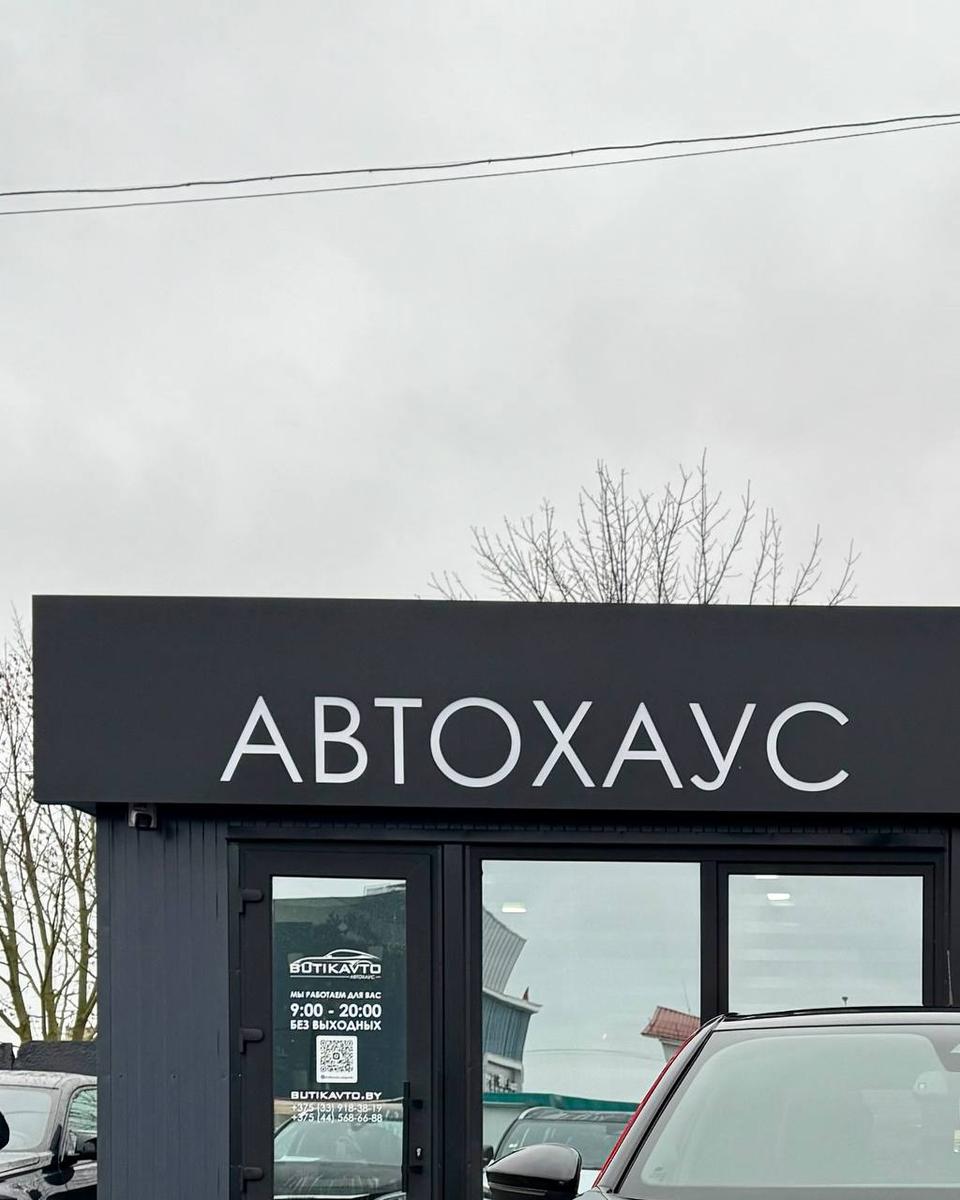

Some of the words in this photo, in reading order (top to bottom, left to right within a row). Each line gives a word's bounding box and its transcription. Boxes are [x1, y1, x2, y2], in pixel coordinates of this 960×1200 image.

[221, 695, 848, 792] АВТОХАУС
[289, 962, 382, 974] BUTIKAVTO
[290, 991, 304, 999] МЫ
[305, 991, 346, 999] РАБОТАЕМ
[290, 1003, 323, 1017] 9:00
[339, 1003, 382, 1018] 20:00
[290, 1020, 309, 1030] БЕЗ
[312, 1020, 381, 1031] ВЫХОДНЫХ
[291, 1091, 382, 1099] BUTIKAVTO.BY
[291, 1104, 315, 1113] +375
[317, 1103, 335, 1115] (33)
[337, 1104, 382, 1112] 918-38-19
[317, 1112, 335, 1123] (44)
[337, 1113, 383, 1122] 568-66-88
